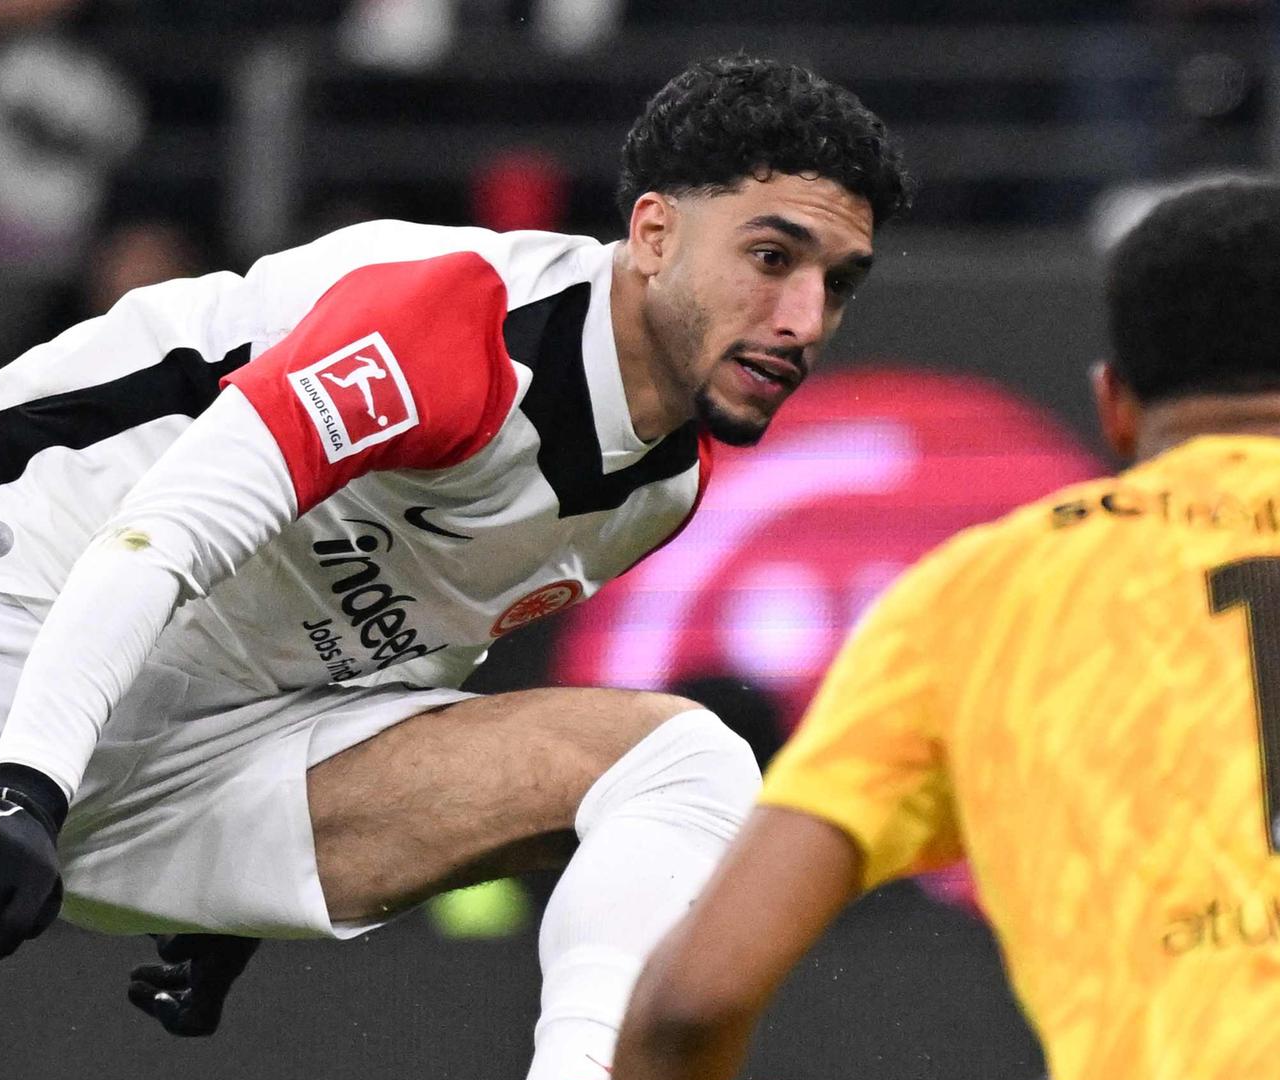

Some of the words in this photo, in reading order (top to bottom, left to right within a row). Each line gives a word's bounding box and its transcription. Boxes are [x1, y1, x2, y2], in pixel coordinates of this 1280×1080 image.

[299, 376, 344, 452] BUNDESLIGA
[312, 518, 449, 670] indeed
[302, 618, 343, 662] Jobs
